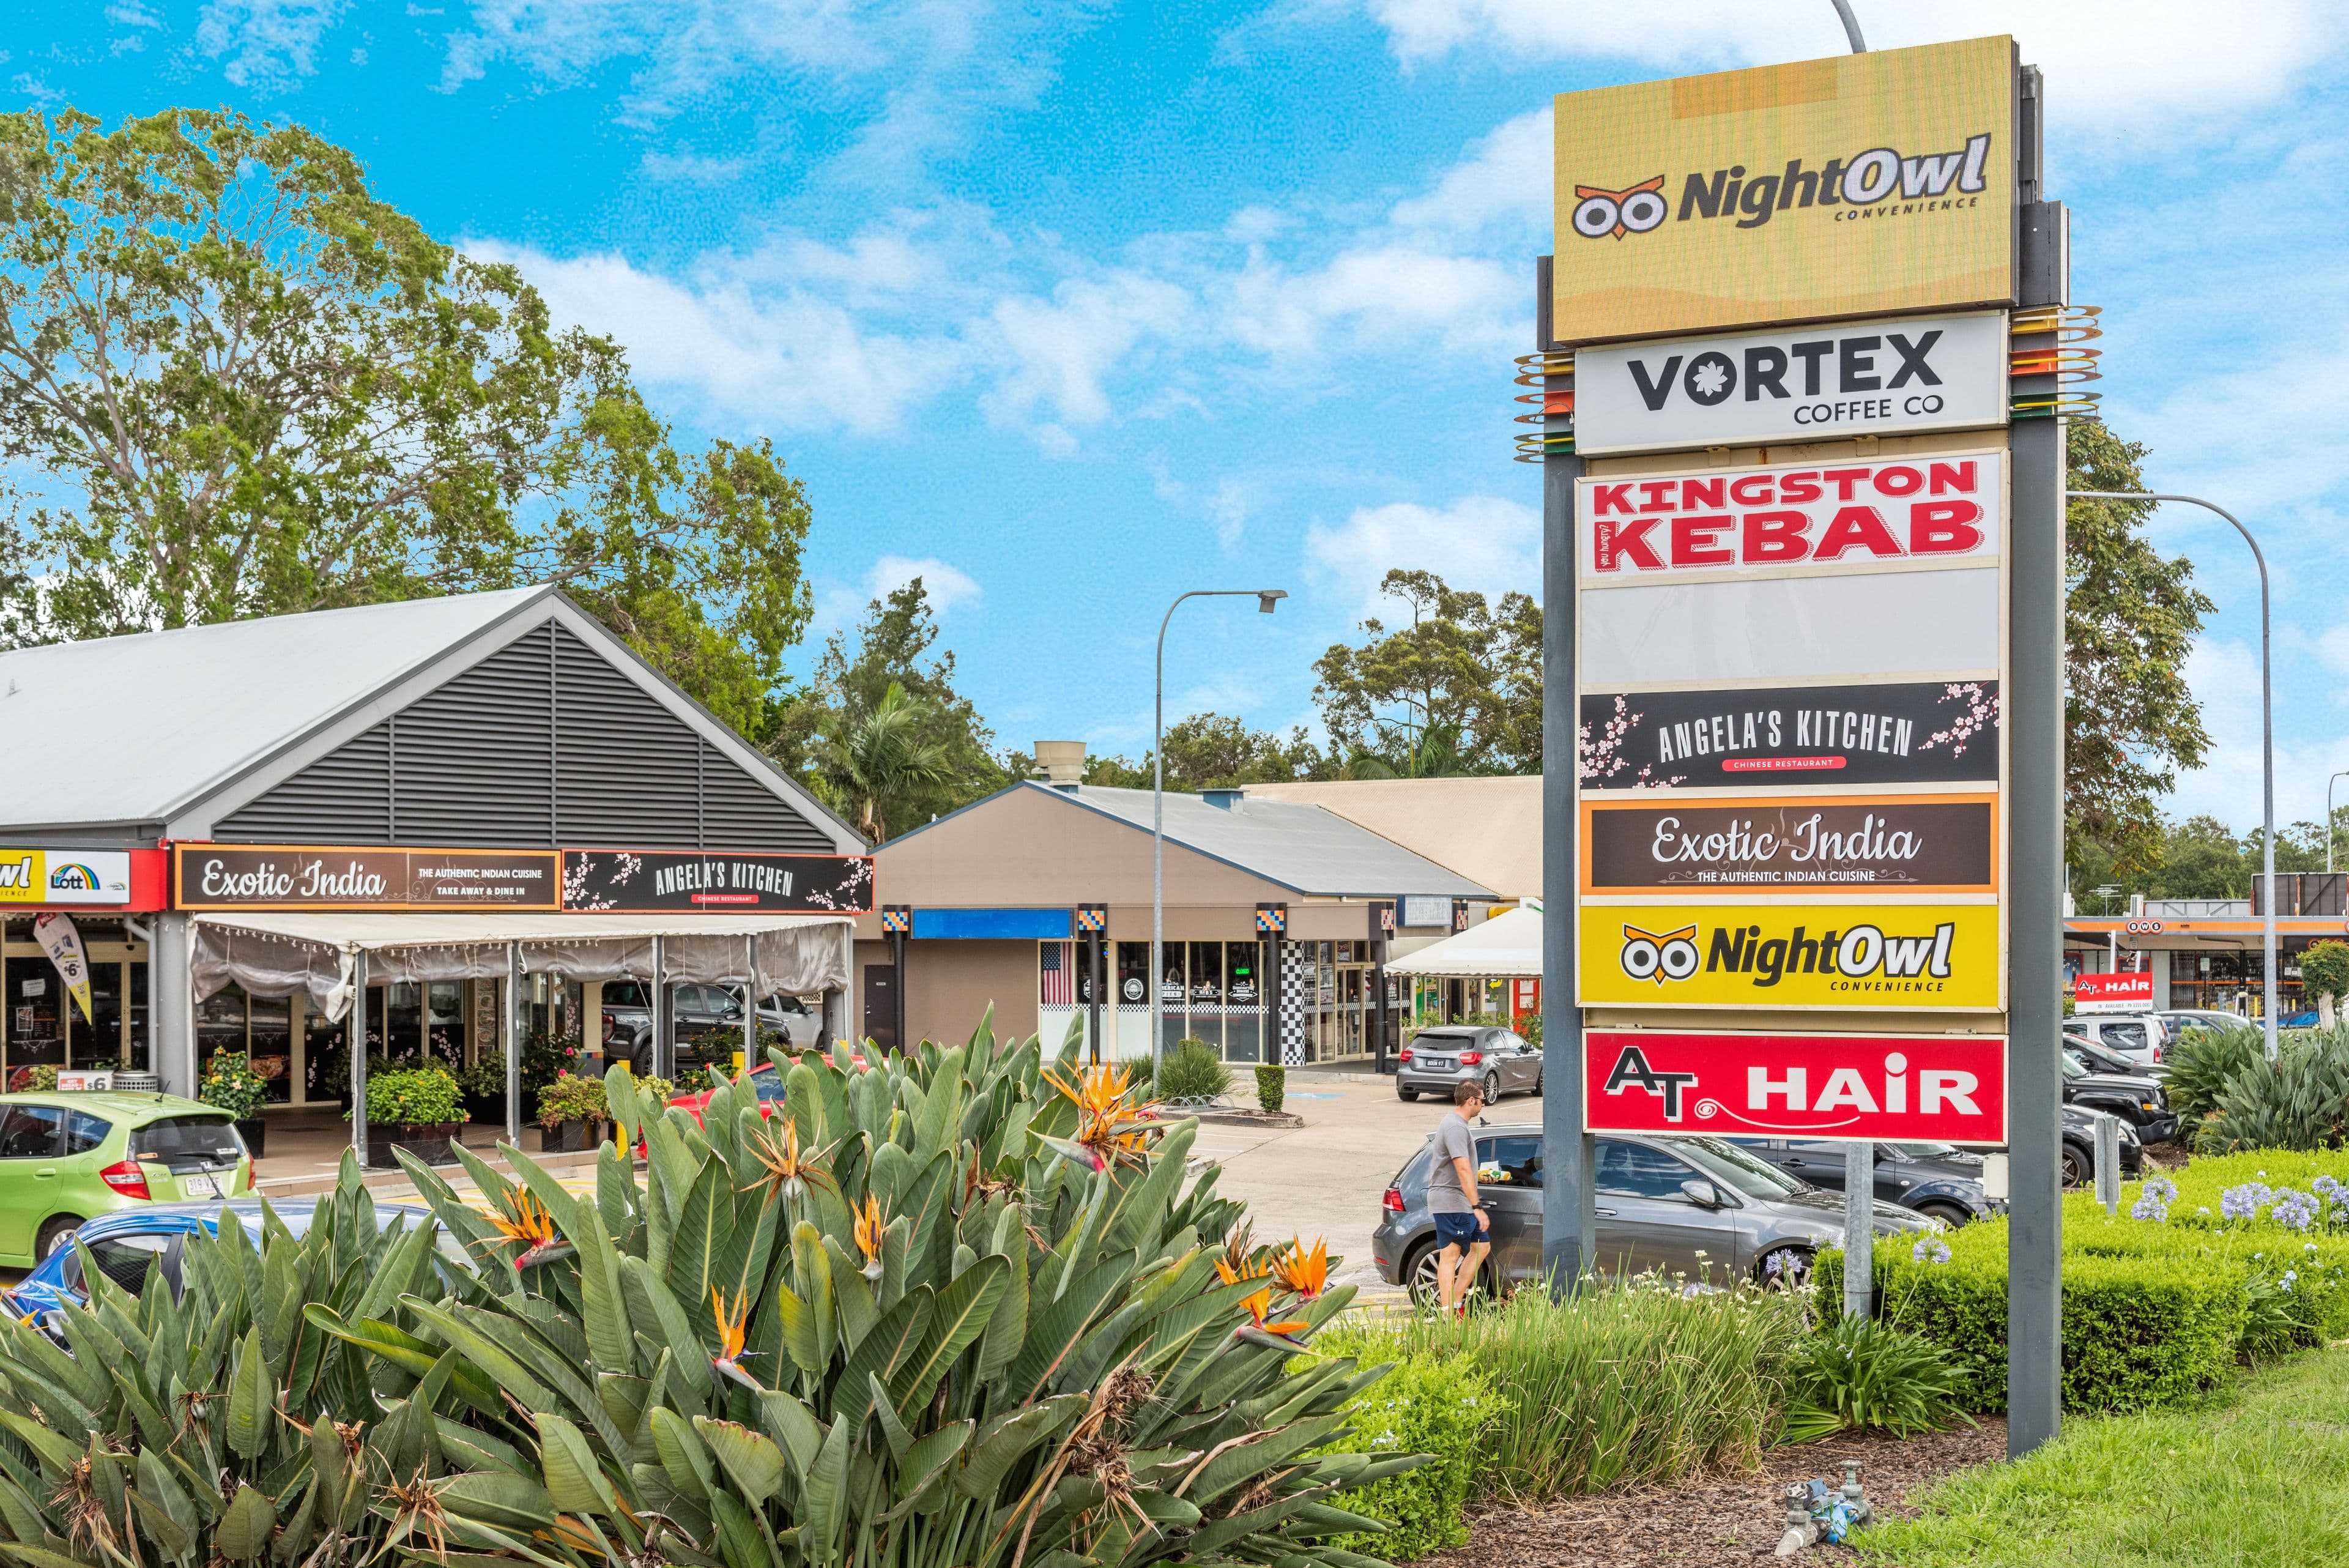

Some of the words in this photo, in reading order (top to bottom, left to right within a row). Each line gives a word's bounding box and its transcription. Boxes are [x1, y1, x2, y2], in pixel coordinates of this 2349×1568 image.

[1677, 132, 1992, 229] NightOwl
[1835, 196, 1978, 222] CONVENIENCE
[1627, 330, 1943, 411] VORTEX
[1794, 398, 1891, 425] COFFEE
[1904, 395, 1944, 415] CO
[1594, 461, 1978, 516] KINGSTON
[1594, 499, 1984, 573] KEBAB
[1600, 553, 1611, 567] you
[1658, 710, 1781, 764] ANGELA'S
[1797, 710, 1913, 757] KITCHEN
[1775, 759, 1833, 768] RESTAURANT
[1652, 817, 1781, 863] Exotic
[1790, 813, 1922, 861] India
[201, 859, 294, 896] Exotic
[300, 859, 387, 896] India
[418, 868, 433, 878] THE
[434, 869, 480, 879] AUTHENTIC
[481, 869, 510, 879] INDIAN
[511, 869, 543, 879] CUISINE
[656, 861, 725, 896] ANGELA'S
[732, 863, 793, 897] KITCHEN
[1698, 872, 1717, 882] THE
[1721, 871, 1781, 882] AUTHENTIC
[1784, 871, 1826, 882] INDIAN
[1830, 871, 1876, 881] CUISINE
[1705, 921, 1955, 987] NightOwl
[1830, 981, 1944, 992] CONVENIENCE
